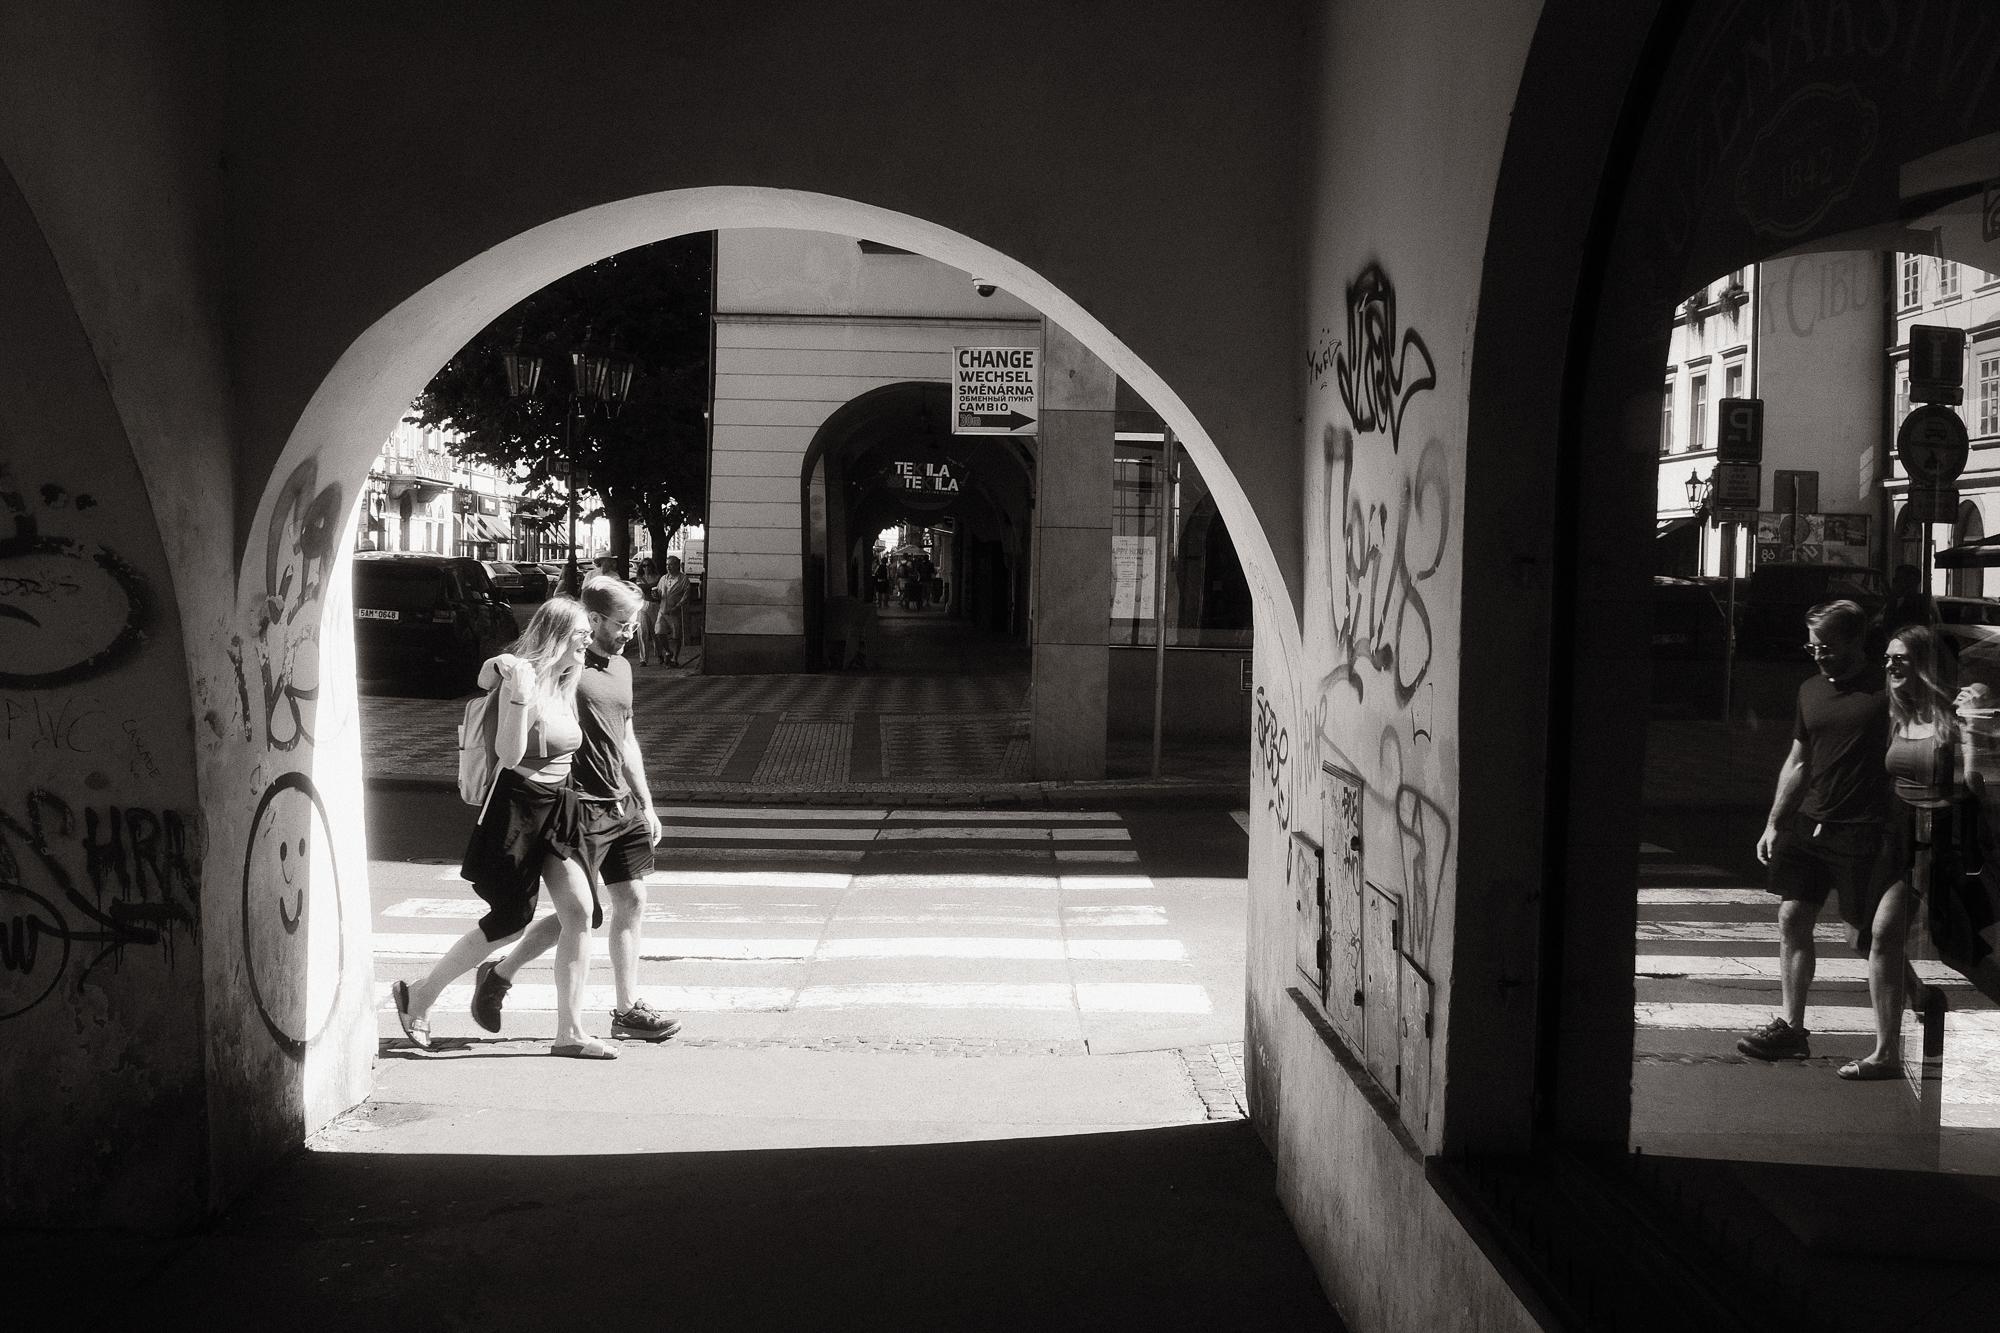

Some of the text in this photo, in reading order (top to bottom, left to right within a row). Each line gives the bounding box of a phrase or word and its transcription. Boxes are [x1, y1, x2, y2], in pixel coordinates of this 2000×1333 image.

[959, 350, 1034, 368] CHANGE
[959, 371, 1033, 382] WECHSEL
[959, 383, 1034, 395] SMĚNÁRNA
[959, 394, 1006, 402] ОБМЕННЫЙ
[959, 403, 1009, 411] CAMBIO
